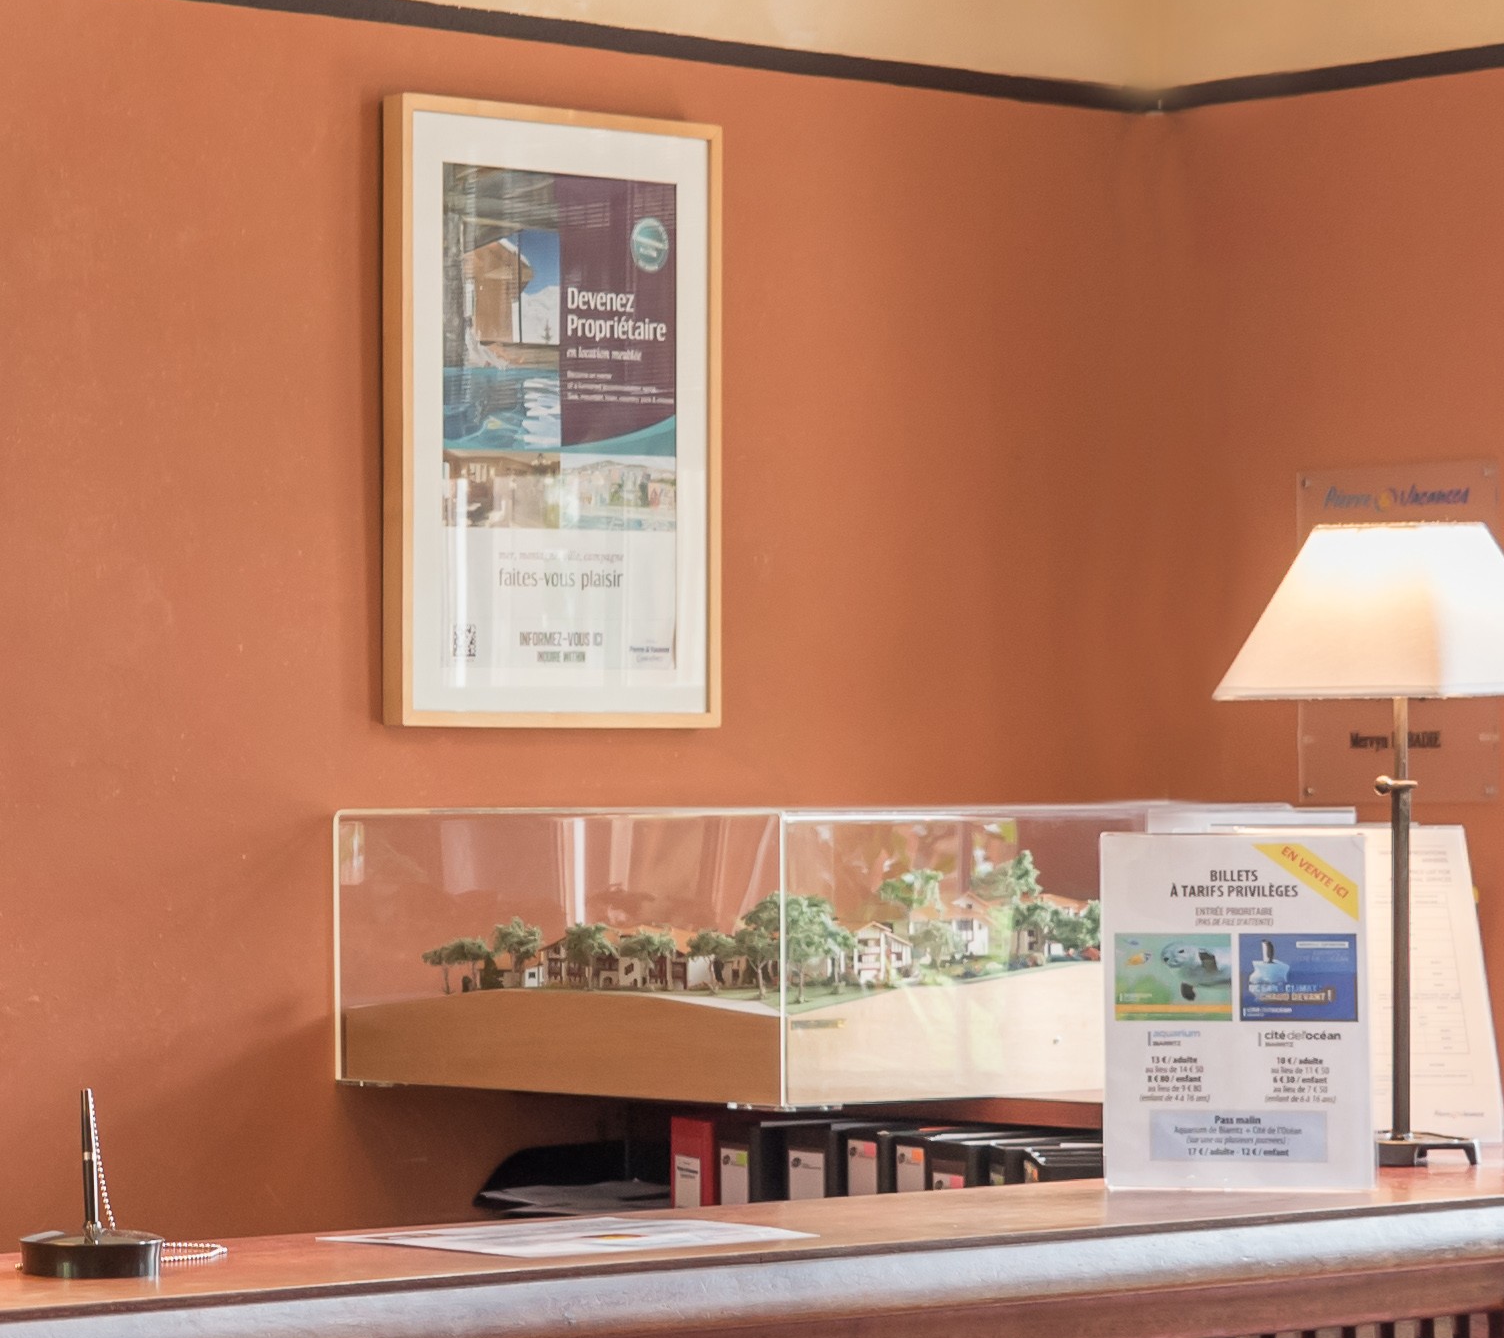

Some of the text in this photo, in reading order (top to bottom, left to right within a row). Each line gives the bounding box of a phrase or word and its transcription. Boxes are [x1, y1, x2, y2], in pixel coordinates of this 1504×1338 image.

[567, 287, 635, 312] Devenez
[567, 314, 667, 341] Propriétaire
[499, 568, 624, 591] faites-vous plaisir
[519, 631, 590, 646] INFORMEZ-VOUS
[1209, 869, 1258, 882] BILLETS
[1281, 845, 1349, 900] EN VENTE ICI
[1170, 882, 1299, 898] À TARIFS PRIVILÈGES
[1195, 906, 1223, 916] ENTRÉE
[1214, 1115, 1261, 1124] Pass malin
